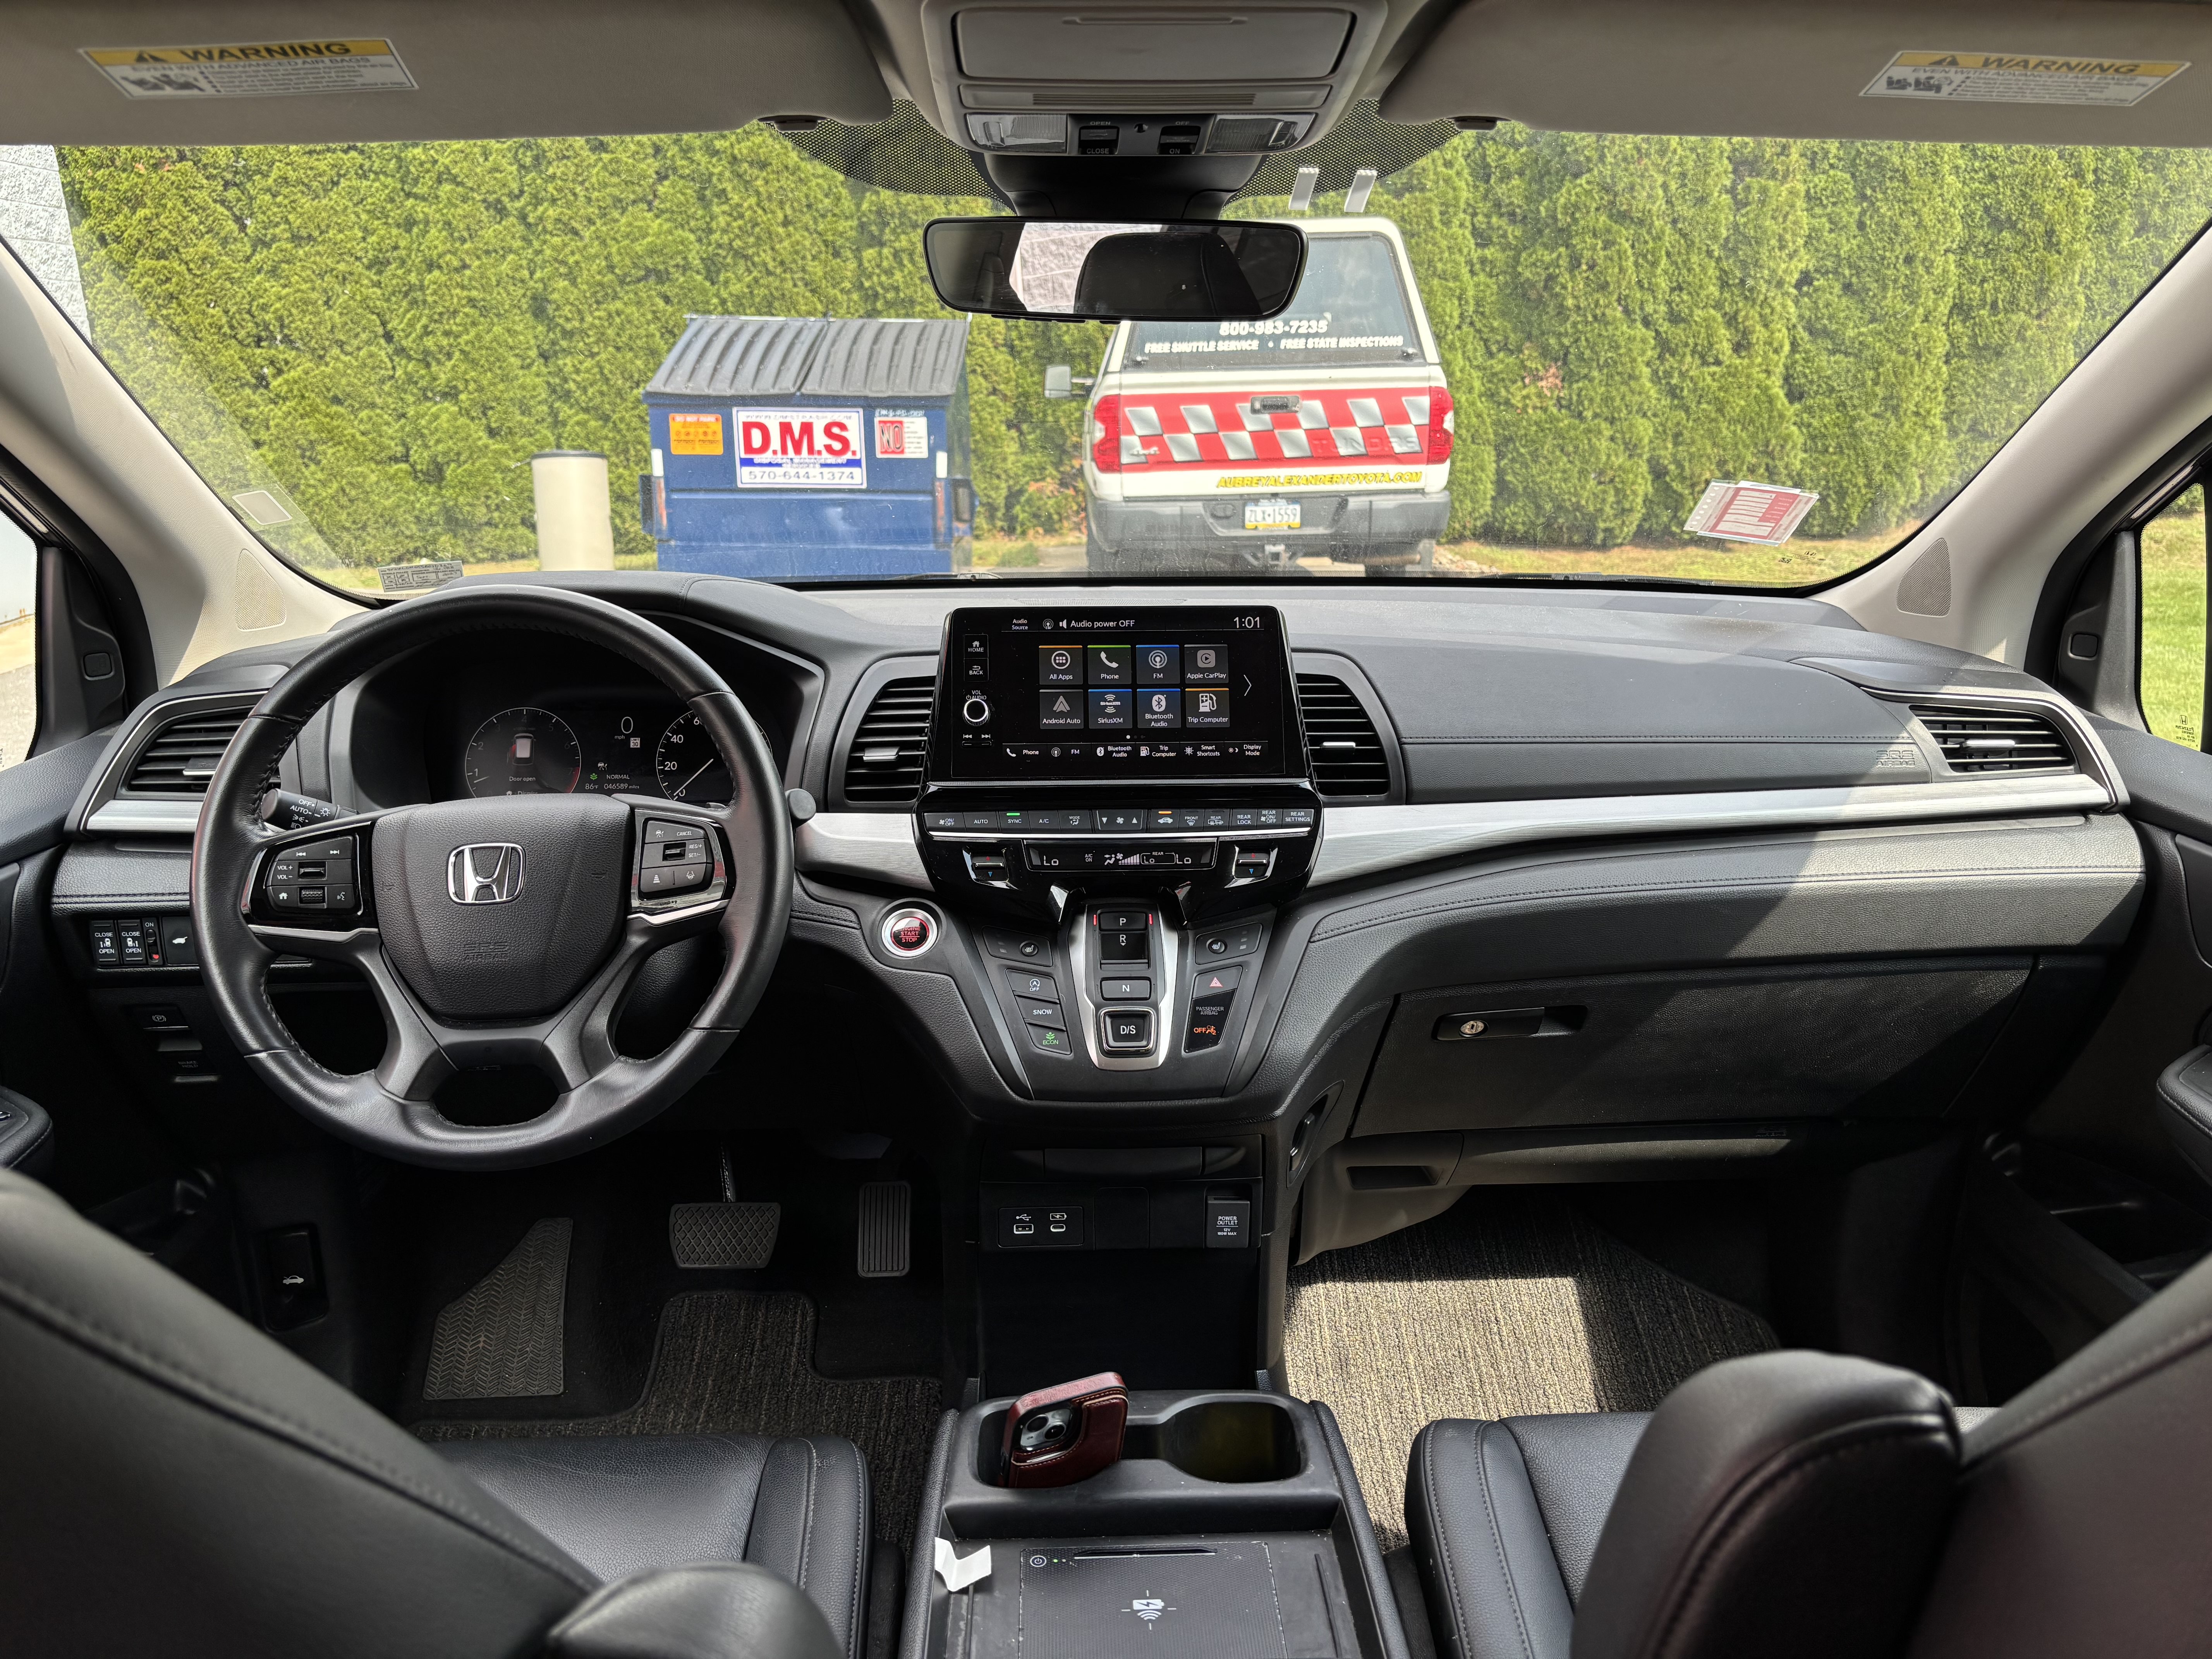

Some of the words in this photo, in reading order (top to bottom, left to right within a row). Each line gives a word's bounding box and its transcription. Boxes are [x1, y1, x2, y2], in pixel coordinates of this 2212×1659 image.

[179, 43, 351, 61] WARNING
[217, 59, 299, 69] ADVANCED
[1982, 57, 2140, 74] WARNING
[1144, 342, 1171, 353] FREE
[1171, 341, 1216, 352] SHUTTLE
[1216, 339, 1259, 351] SERVICE
[1280, 338, 1306, 349] FREE
[1306, 337, 1338, 349] STATE
[1338, 335, 1403, 348] INSPECTIONS
[742, 421, 857, 457] D.M.S.
[879, 423, 903, 452] NO
[749, 470, 855, 480] 570-644-1374
[1216, 471, 1422, 488] AUBREYALEXANDERTOYOTA.COM
[1233, 617, 1260, 629] 1:01
[621, 716, 633, 734] 0
[694, 717, 702, 725] 6
[670, 735, 684, 743] 40
[1876, 750, 1914, 759] SRS
[665, 761, 677, 770] 20
[474, 768, 478, 776] 1
[290, 805, 309, 814] AUTO
[1120, 918, 1126, 926] P
[1120, 934, 1126, 943] R
[1120, 1025, 1136, 1034] D/S
